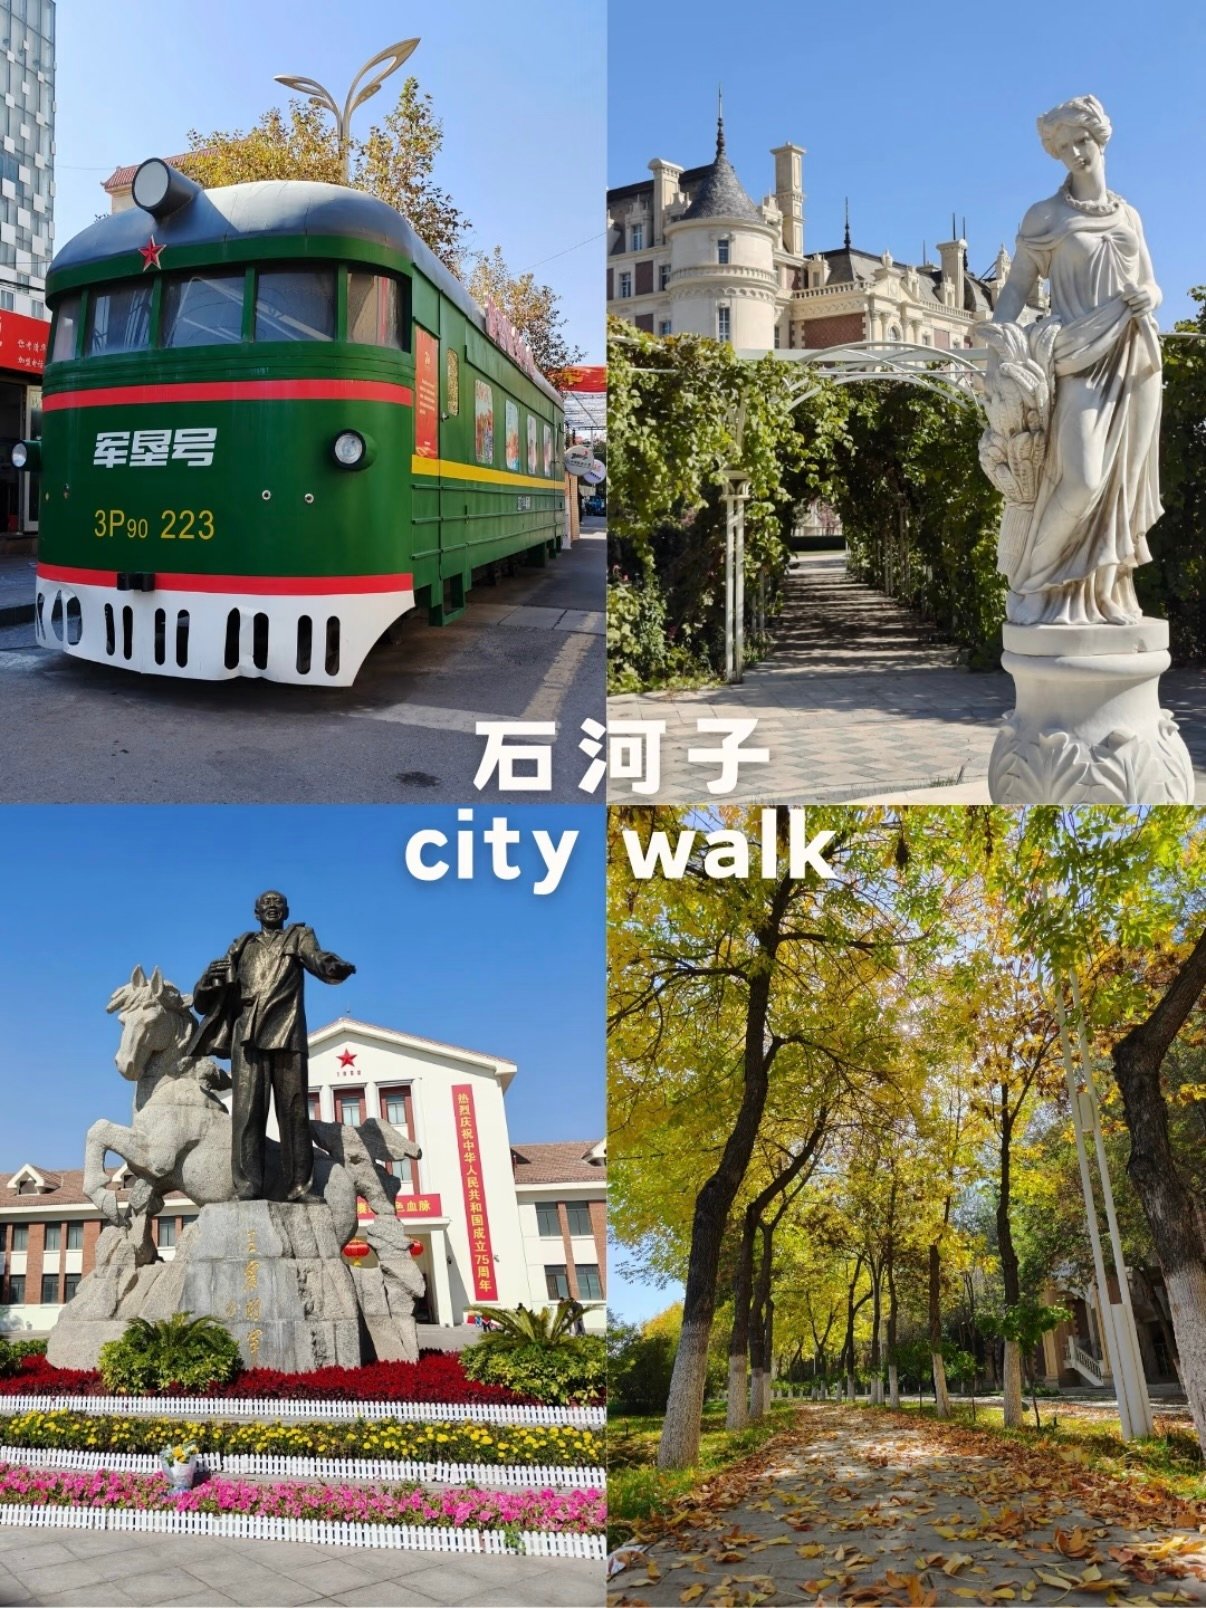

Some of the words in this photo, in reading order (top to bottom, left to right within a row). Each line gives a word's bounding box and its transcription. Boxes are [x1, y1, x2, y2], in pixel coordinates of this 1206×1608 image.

[93, 427, 218, 469] 军垦号
[94, 509, 149, 539] 3P90
[160, 509, 215, 540] 223
[457, 1093, 493, 1294] 热烈庆祝中华人民共和国成立75周年
